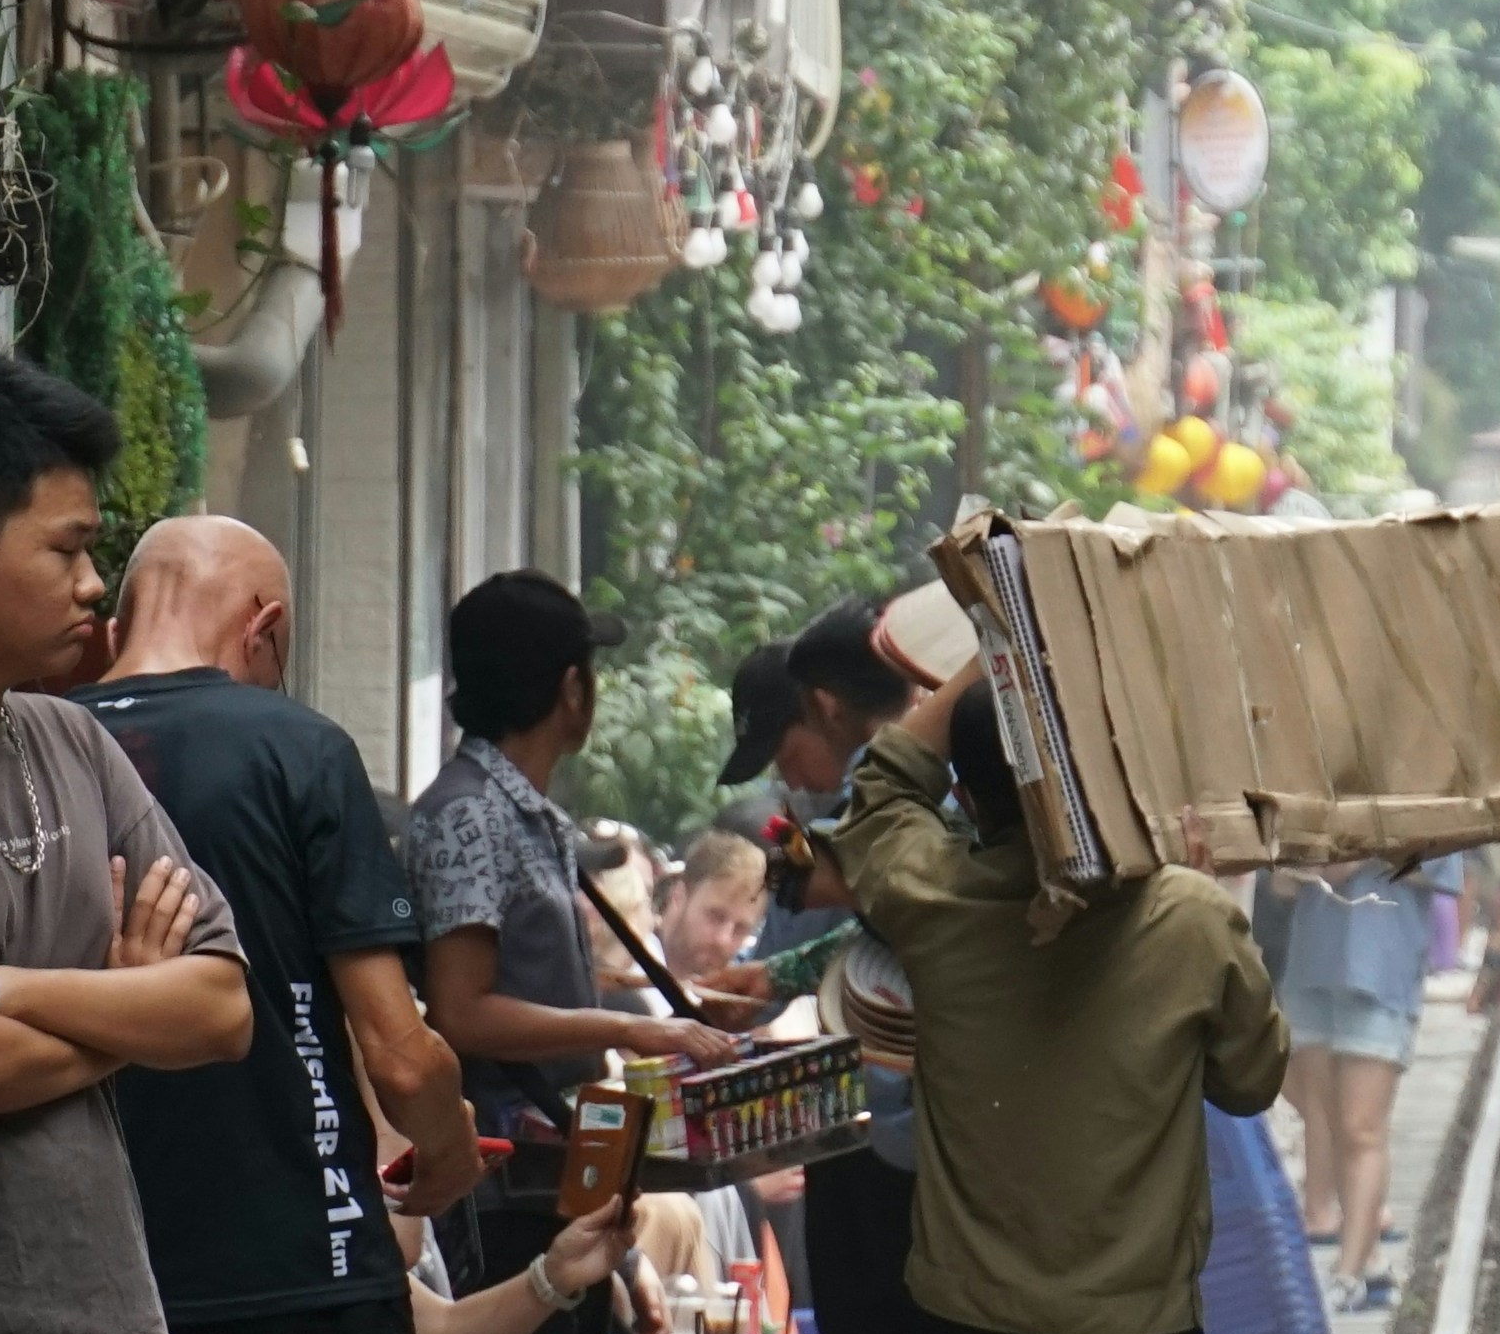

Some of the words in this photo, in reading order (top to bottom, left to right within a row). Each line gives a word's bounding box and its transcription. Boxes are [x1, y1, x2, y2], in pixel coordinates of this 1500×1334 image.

[290, 982, 340, 1157] FINISHER
[324, 1167, 363, 1222] 21
[329, 1230, 351, 1277] km
